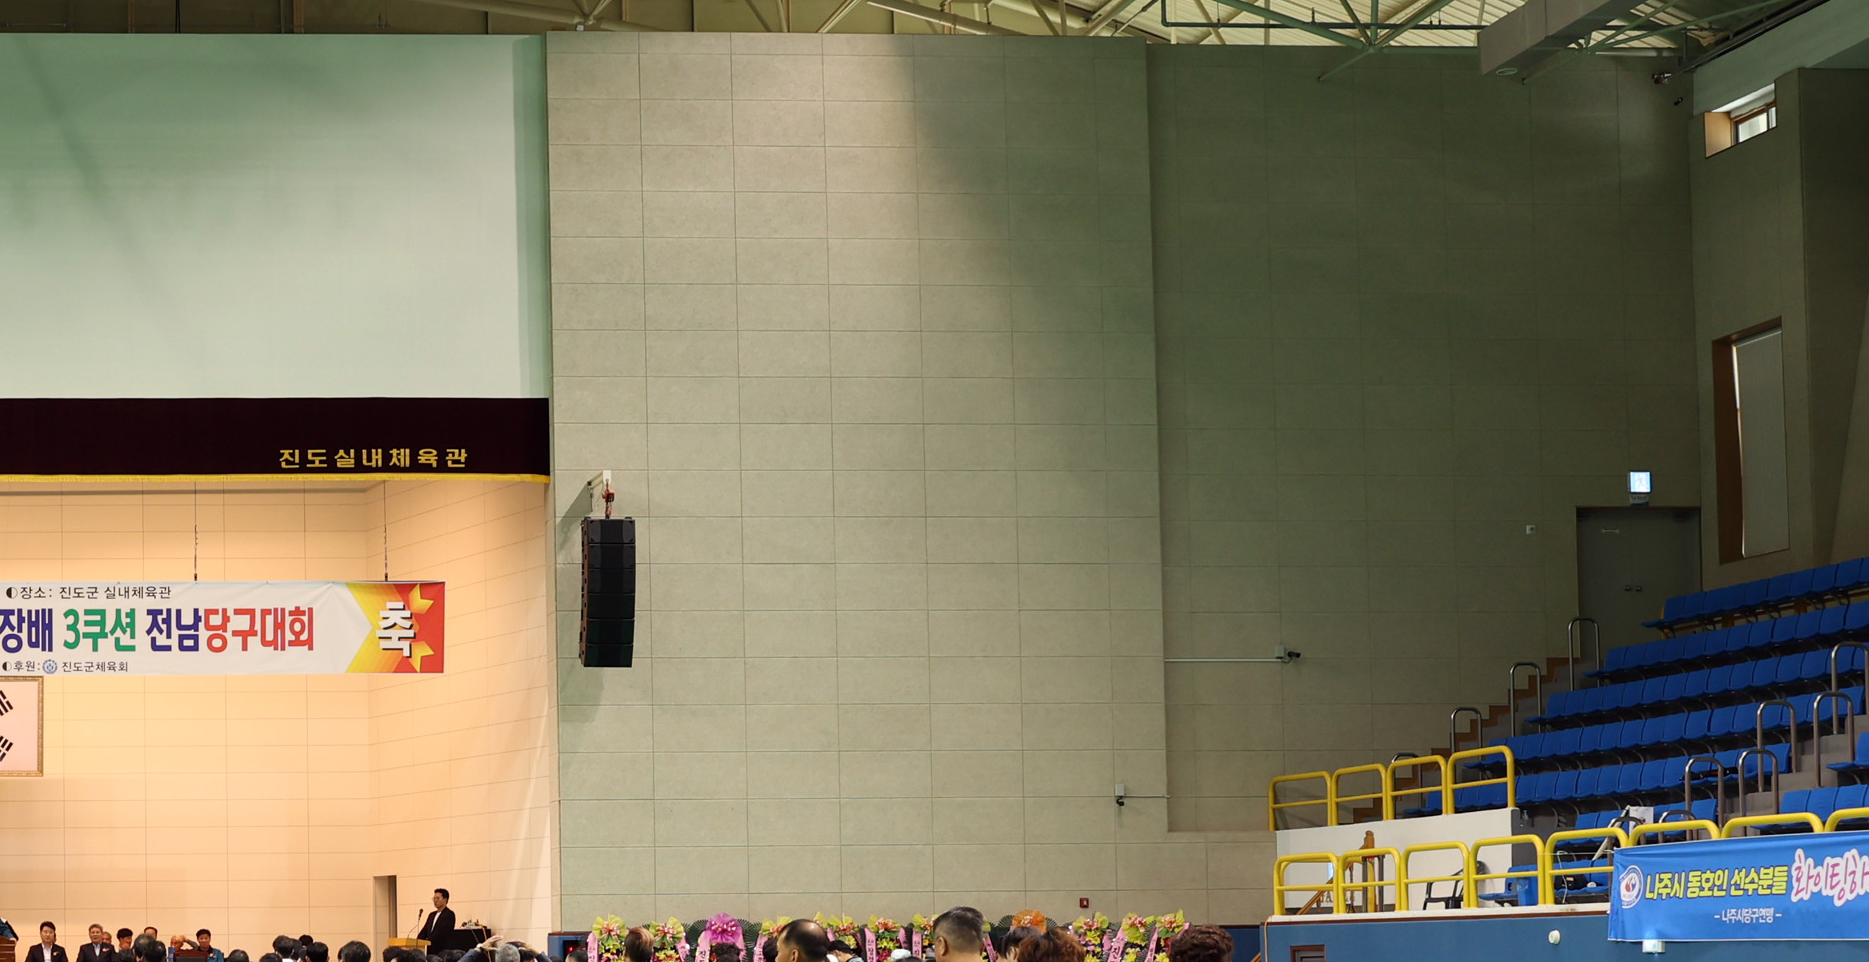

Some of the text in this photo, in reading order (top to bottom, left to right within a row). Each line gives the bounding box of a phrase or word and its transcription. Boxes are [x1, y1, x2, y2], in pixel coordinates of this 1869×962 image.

[20, 586, 172, 600] 장소: 진도군 실내체육관
[62, 608, 136, 652] 3쿠션
[375, 601, 416, 658] 축
[13, 661, 41, 672] 후원:
[62, 661, 129, 673] 진도군체육회
[1645, 872, 1686, 900] 나주시
[1687, 869, 1729, 899] 동호인
[1730, 865, 1789, 897] 선수분들
[1722, 907, 1775, 924] 나주시당구연맹
